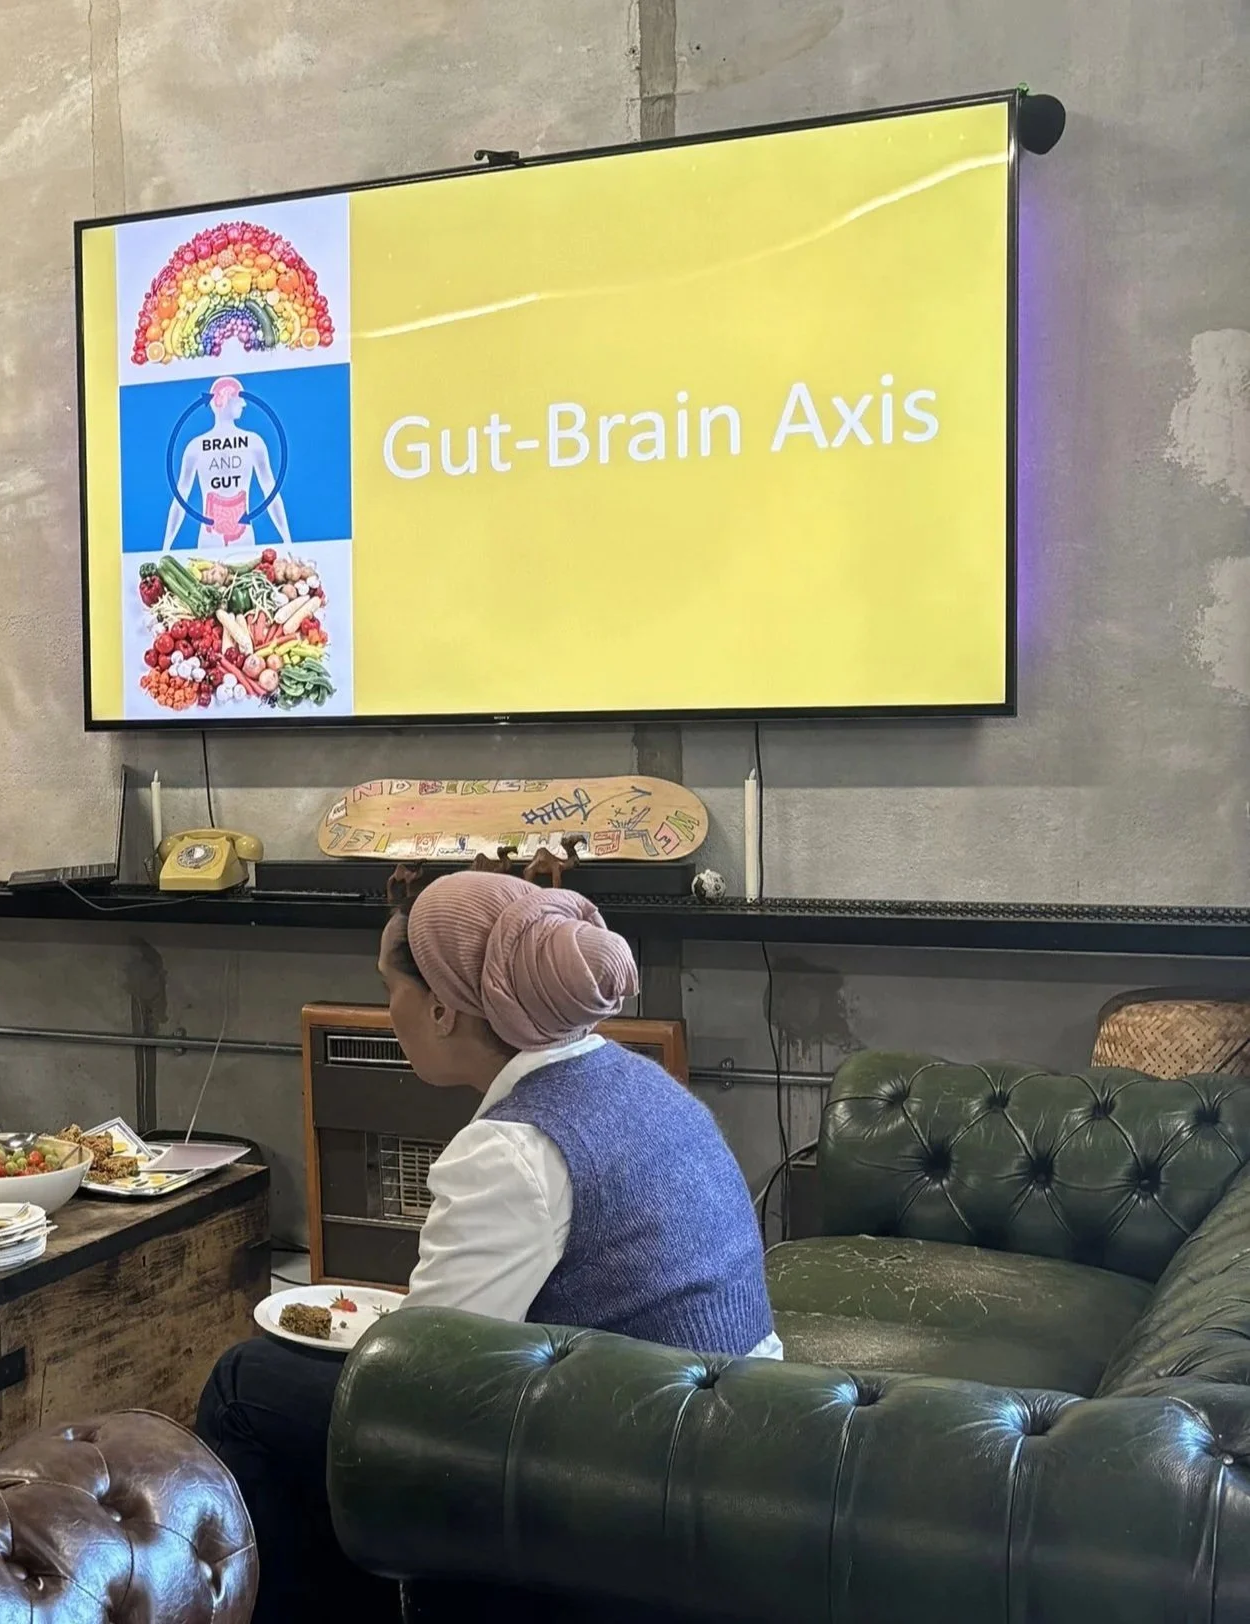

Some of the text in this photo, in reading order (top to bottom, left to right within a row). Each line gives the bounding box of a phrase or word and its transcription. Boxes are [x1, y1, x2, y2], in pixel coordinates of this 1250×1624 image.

[382, 373, 940, 480] Gut-Brain Axis
[202, 436, 248, 451] BRAIN
[209, 455, 242, 470] AND
[210, 475, 241, 489] GUT
